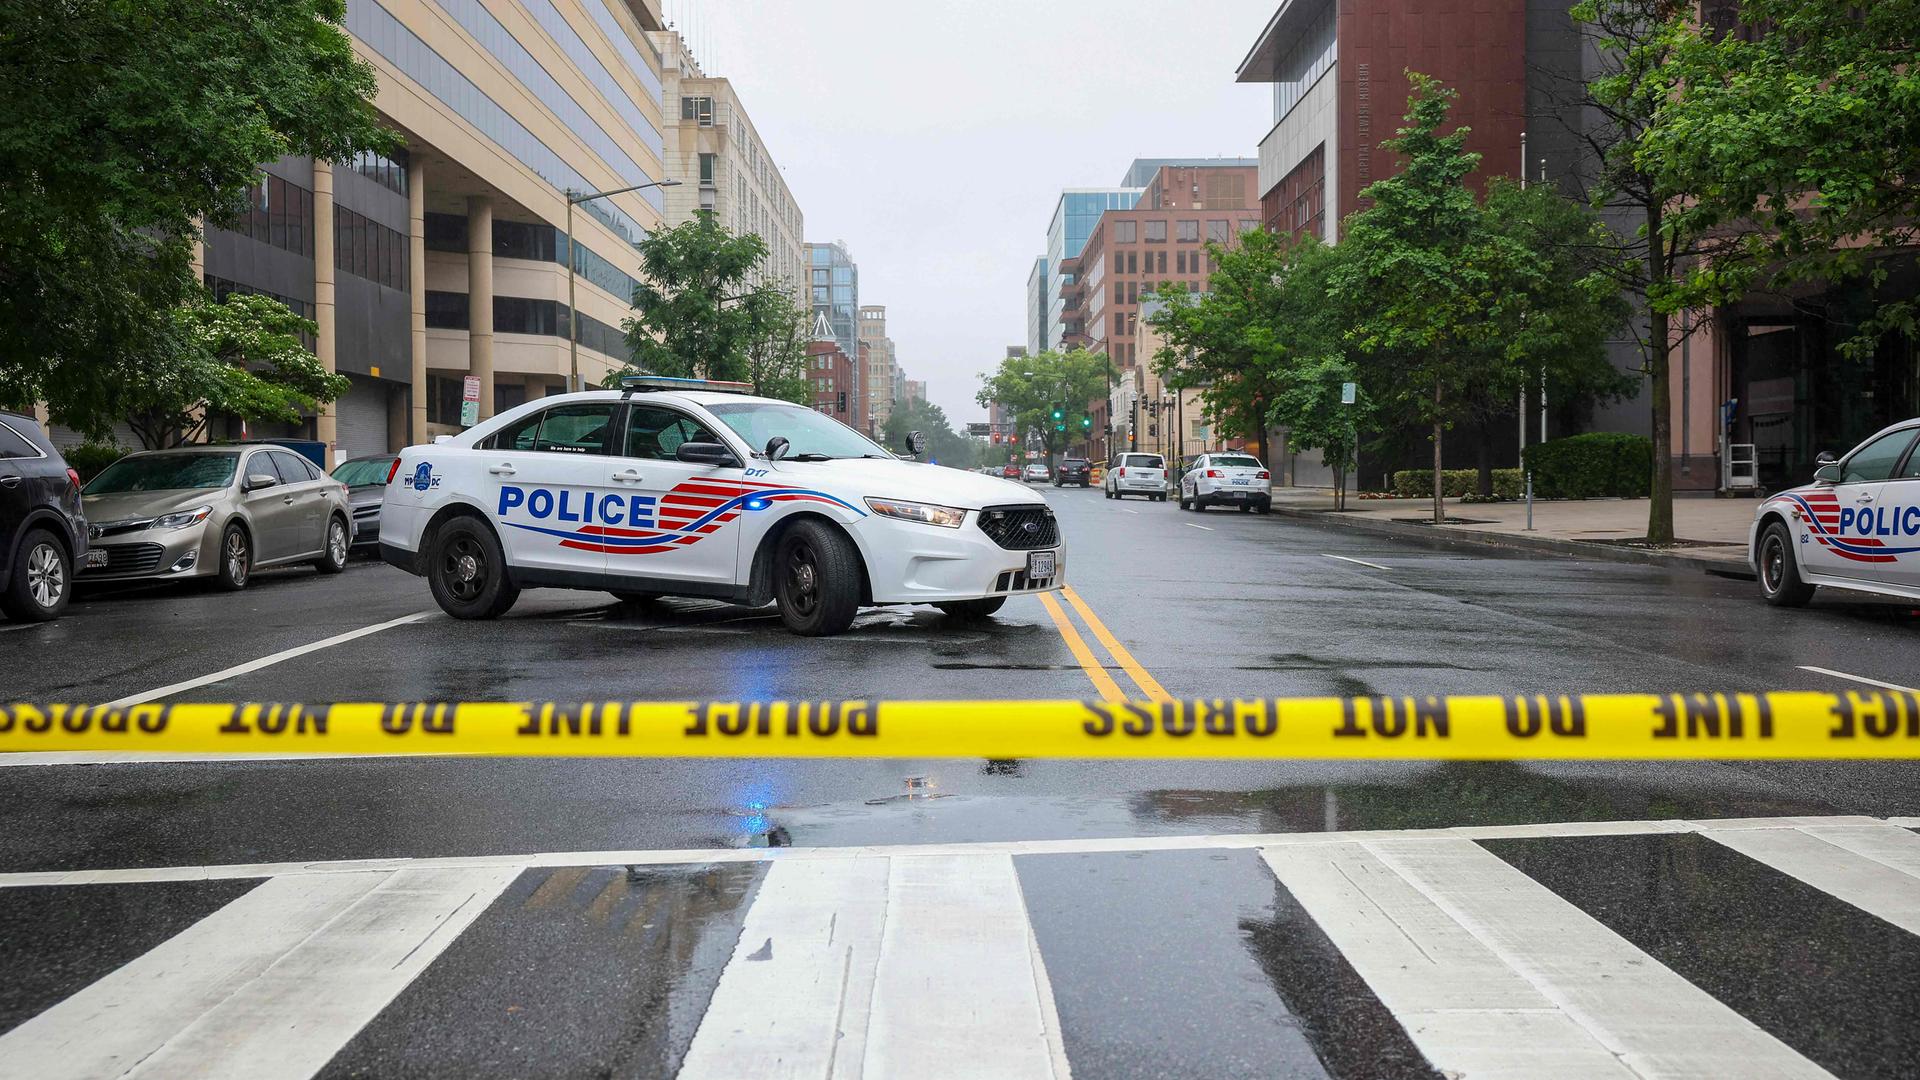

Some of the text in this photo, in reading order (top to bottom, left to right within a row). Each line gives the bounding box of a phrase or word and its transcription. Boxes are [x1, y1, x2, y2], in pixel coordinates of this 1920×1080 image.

[1358, 63, 1369, 100] MUSEUM
[1358, 104, 1369, 138] JEWISH
[1358, 143, 1369, 178] CAPITAL
[404, 477, 441, 487] MP DC
[745, 468, 769, 477] D17
[498, 486, 656, 529] POLICE
[218, 702, 330, 735] NOT
[380, 701, 455, 736] DO
[516, 701, 630, 736] LINE
[684, 700, 878, 737] POLICE
[1082, 699, 1278, 738] CROSS
[1332, 698, 1450, 738] NOT
[1504, 697, 1587, 738] DO
[1651, 693, 1774, 738] LINE
